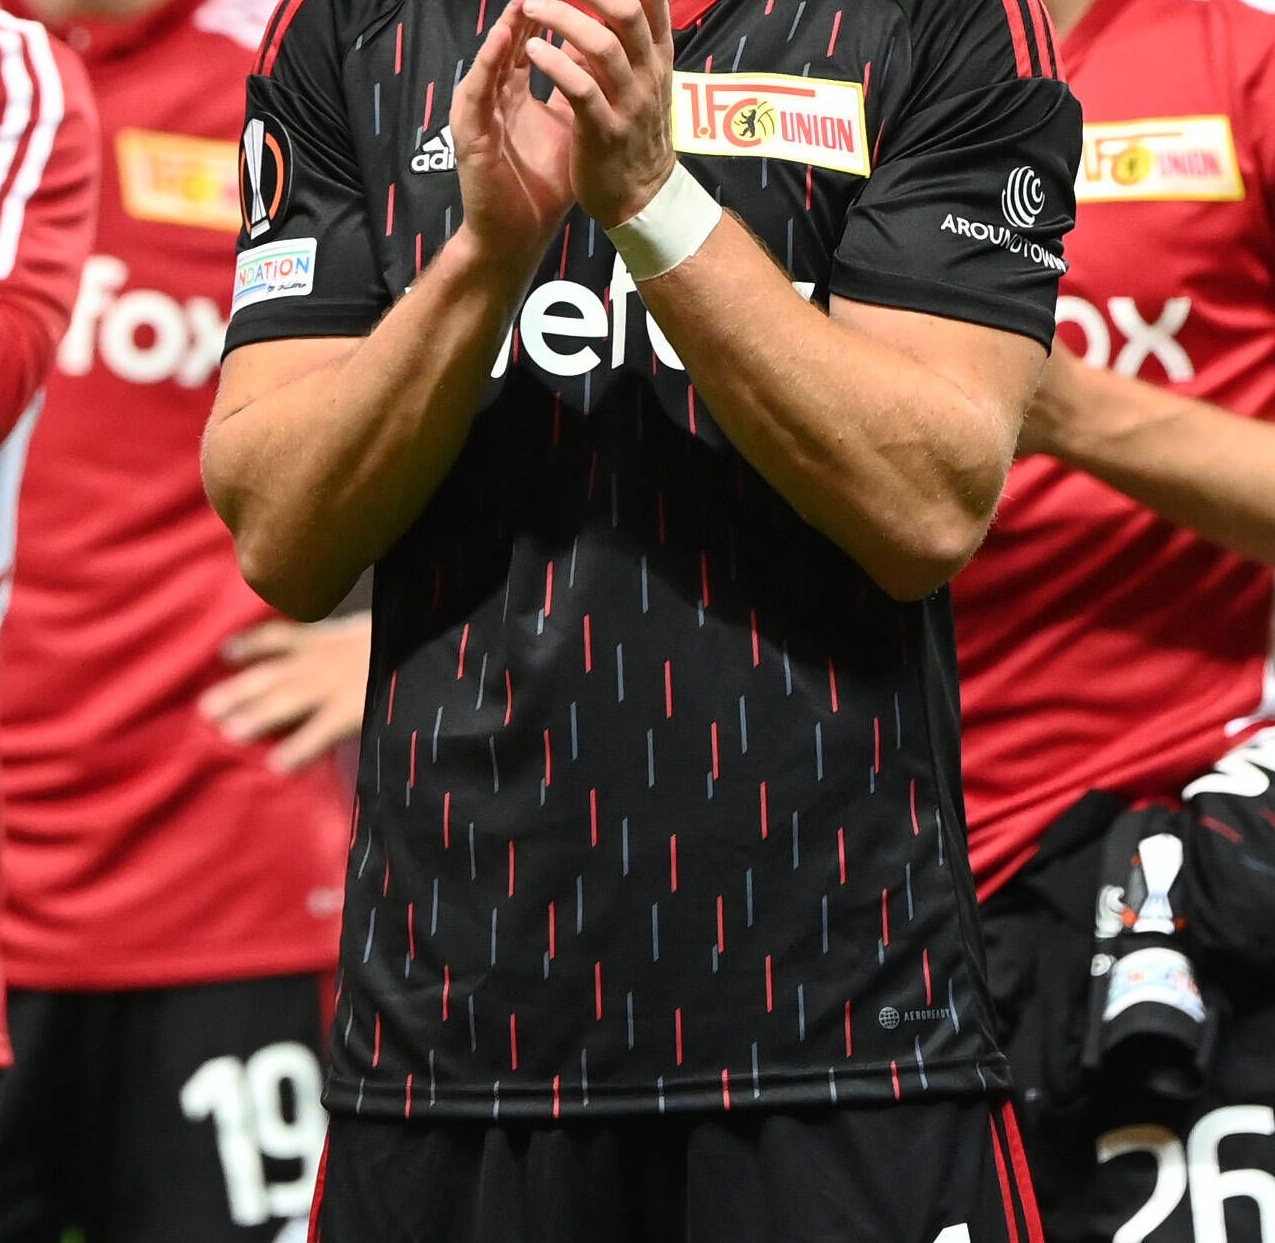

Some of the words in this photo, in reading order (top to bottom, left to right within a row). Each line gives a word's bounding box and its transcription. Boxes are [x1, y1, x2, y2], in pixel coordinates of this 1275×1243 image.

[780, 111, 855, 153] UNION
[411, 146, 457, 172] adi
[179, 1041, 330, 1227] 19
